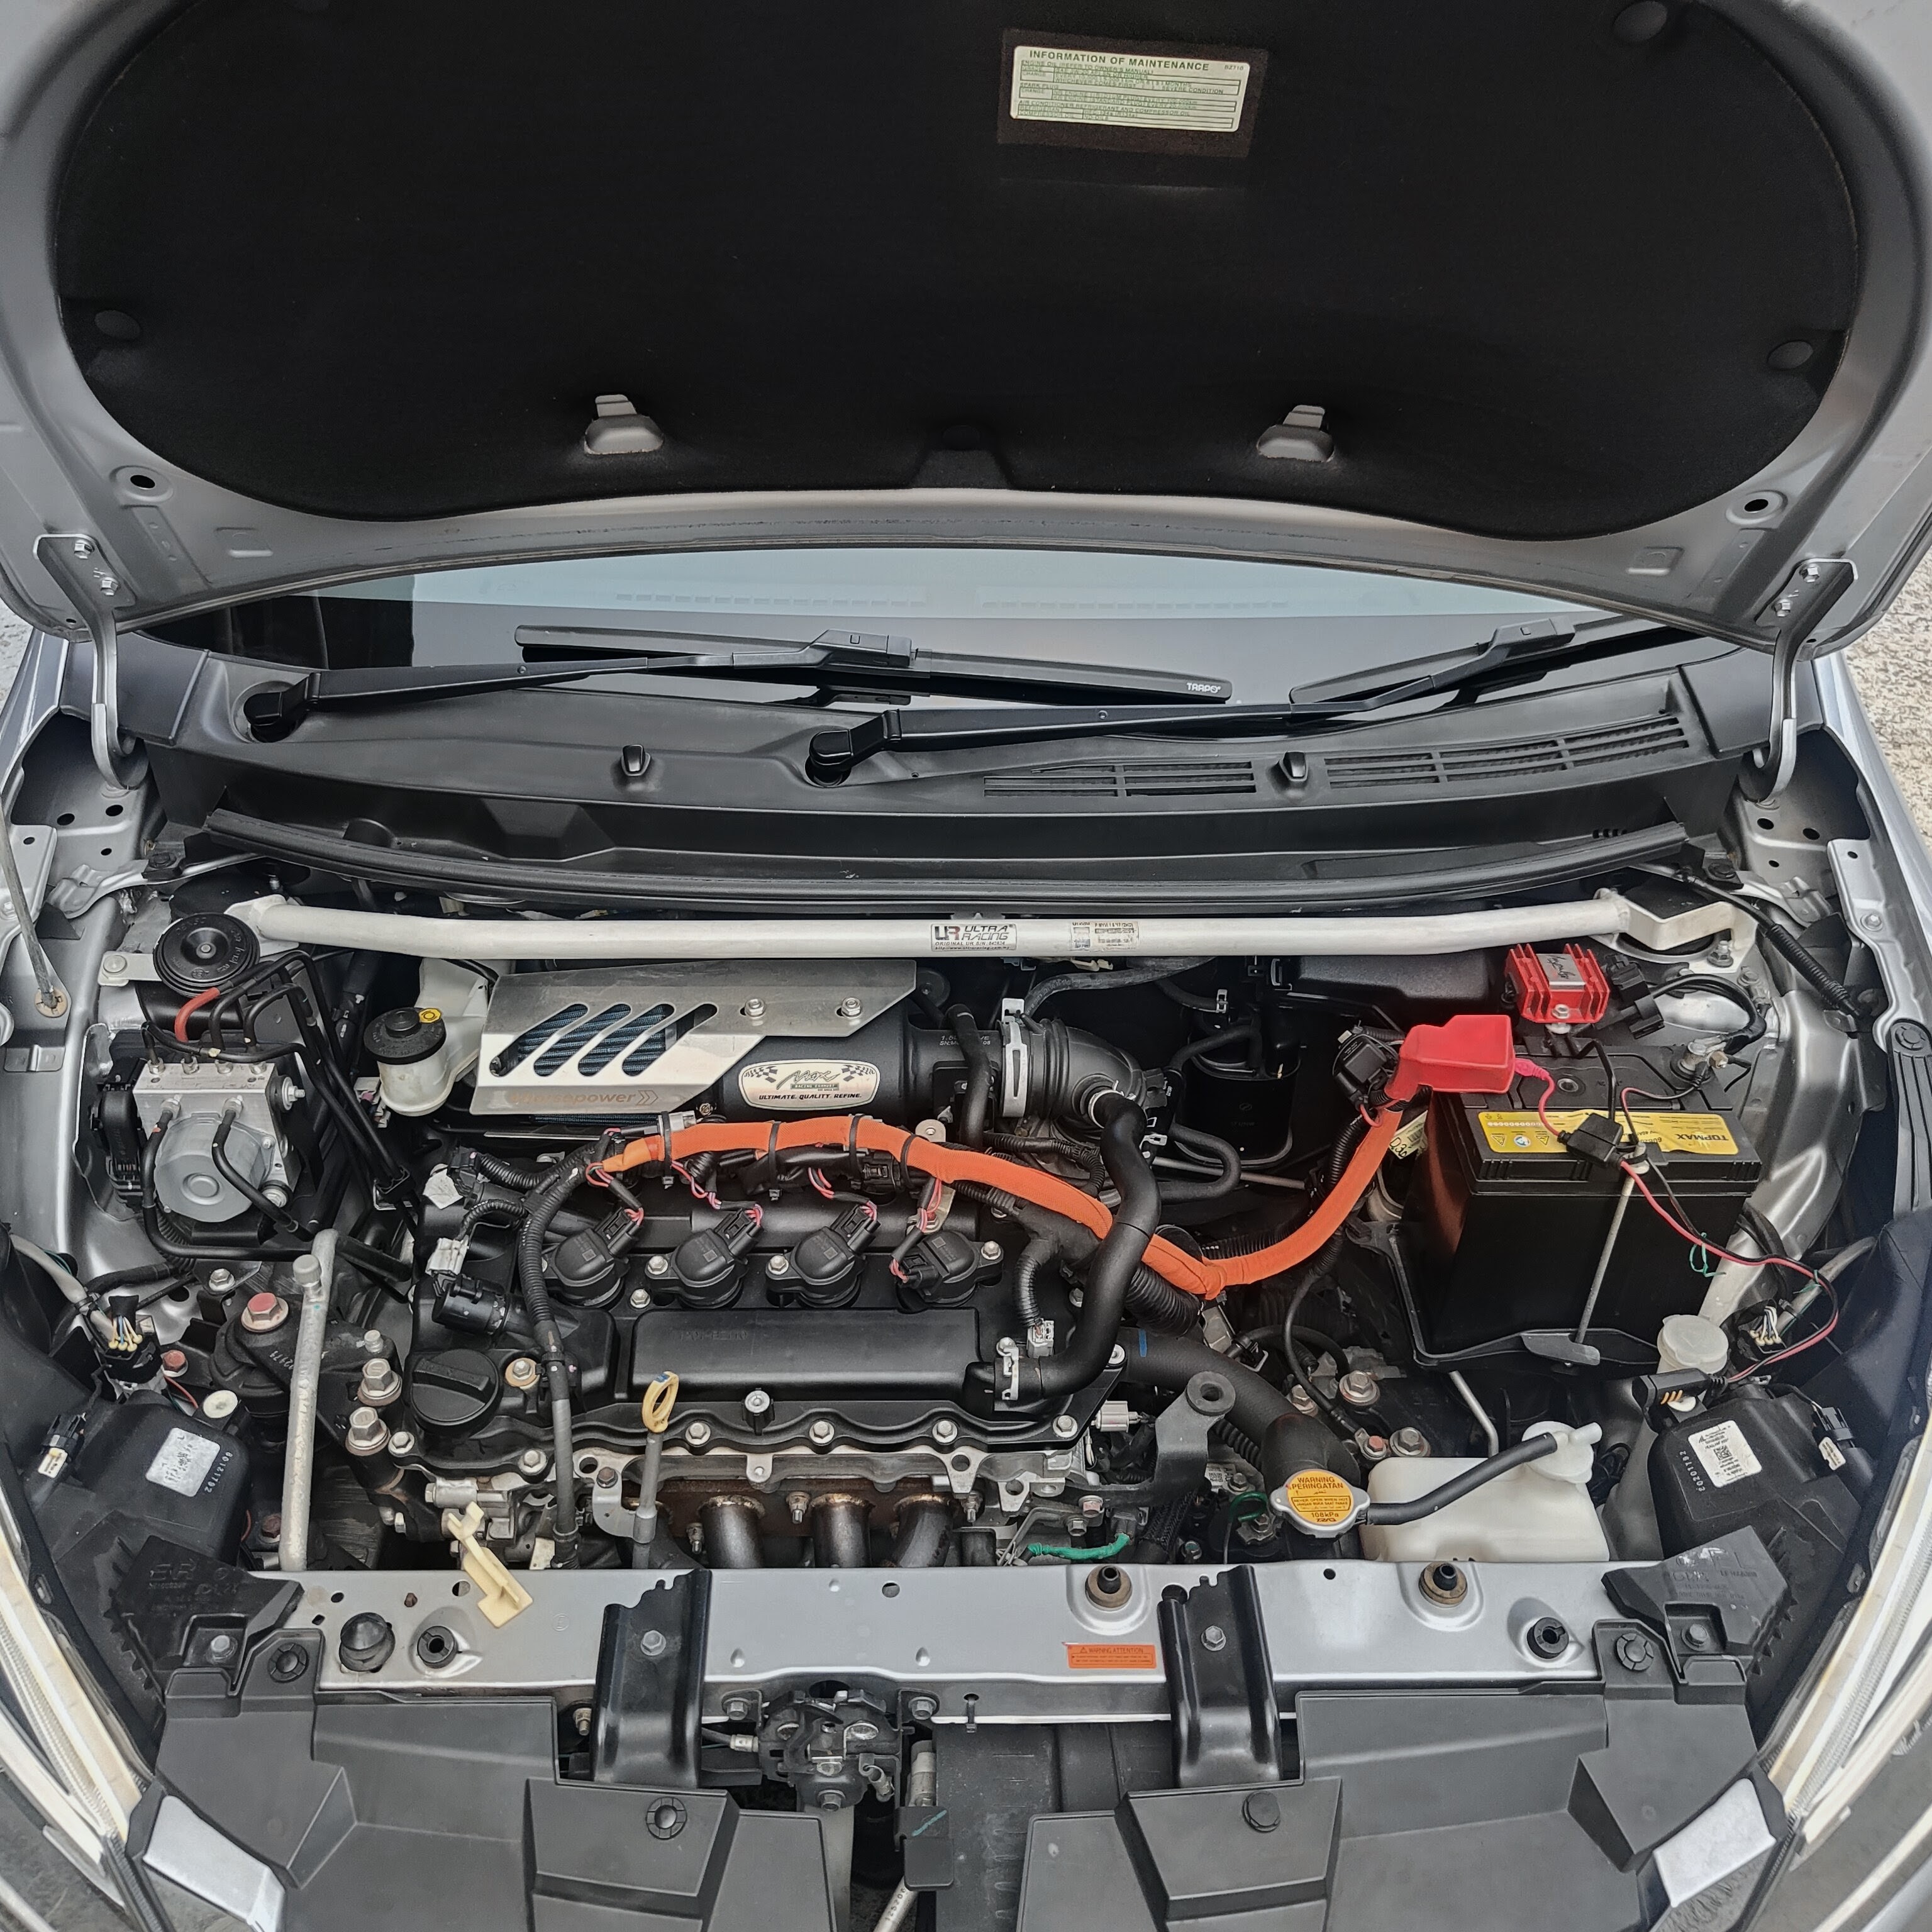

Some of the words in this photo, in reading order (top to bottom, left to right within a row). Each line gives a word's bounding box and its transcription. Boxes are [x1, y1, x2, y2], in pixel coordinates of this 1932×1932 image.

[1030, 50, 1106, 63] INFORMATION
[1129, 58, 1209, 71] MAINTENANCE
[1187, 682, 1218, 693] TRAPO
[961, 932, 1009, 940] RACING
